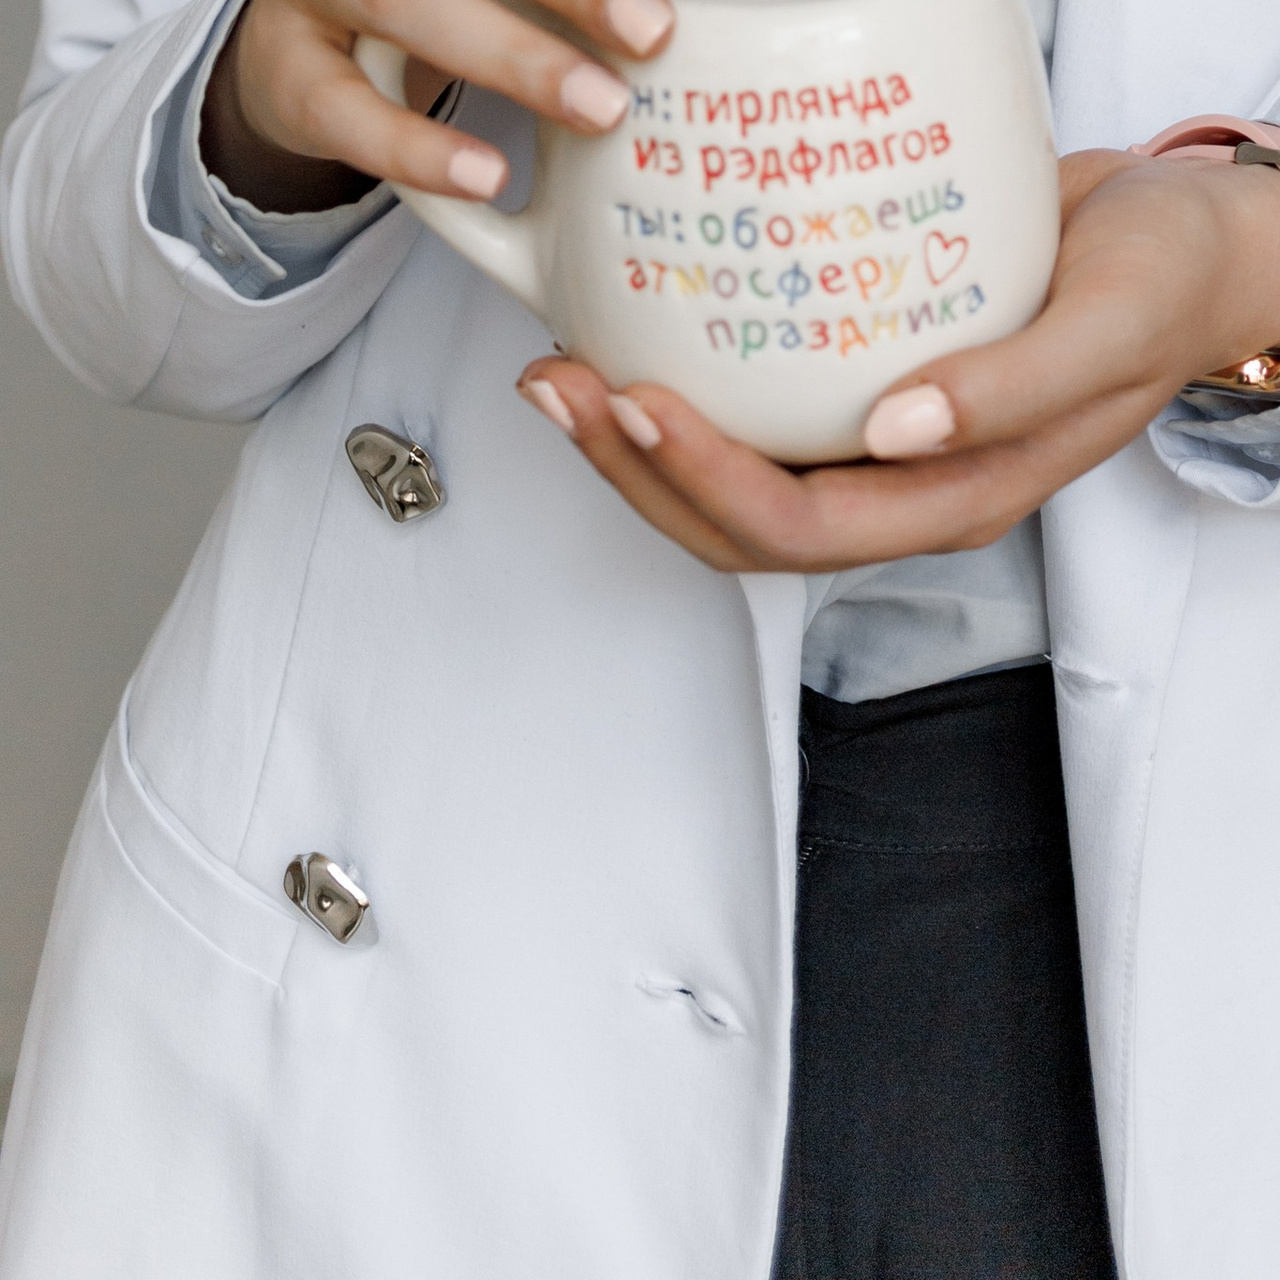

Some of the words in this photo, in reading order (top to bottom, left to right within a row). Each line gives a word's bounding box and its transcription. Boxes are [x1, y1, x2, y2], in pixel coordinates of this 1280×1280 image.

[632, 86, 672, 121] н:
[682, 73, 912, 137] гирлянда
[700, 122, 951, 191] рэдфлагов
[616, 201, 685, 243] ты:
[699, 182, 965, 250] обожаешь
[625, 253, 910, 308] атмосферу
[706, 284, 985, 359] праздника
